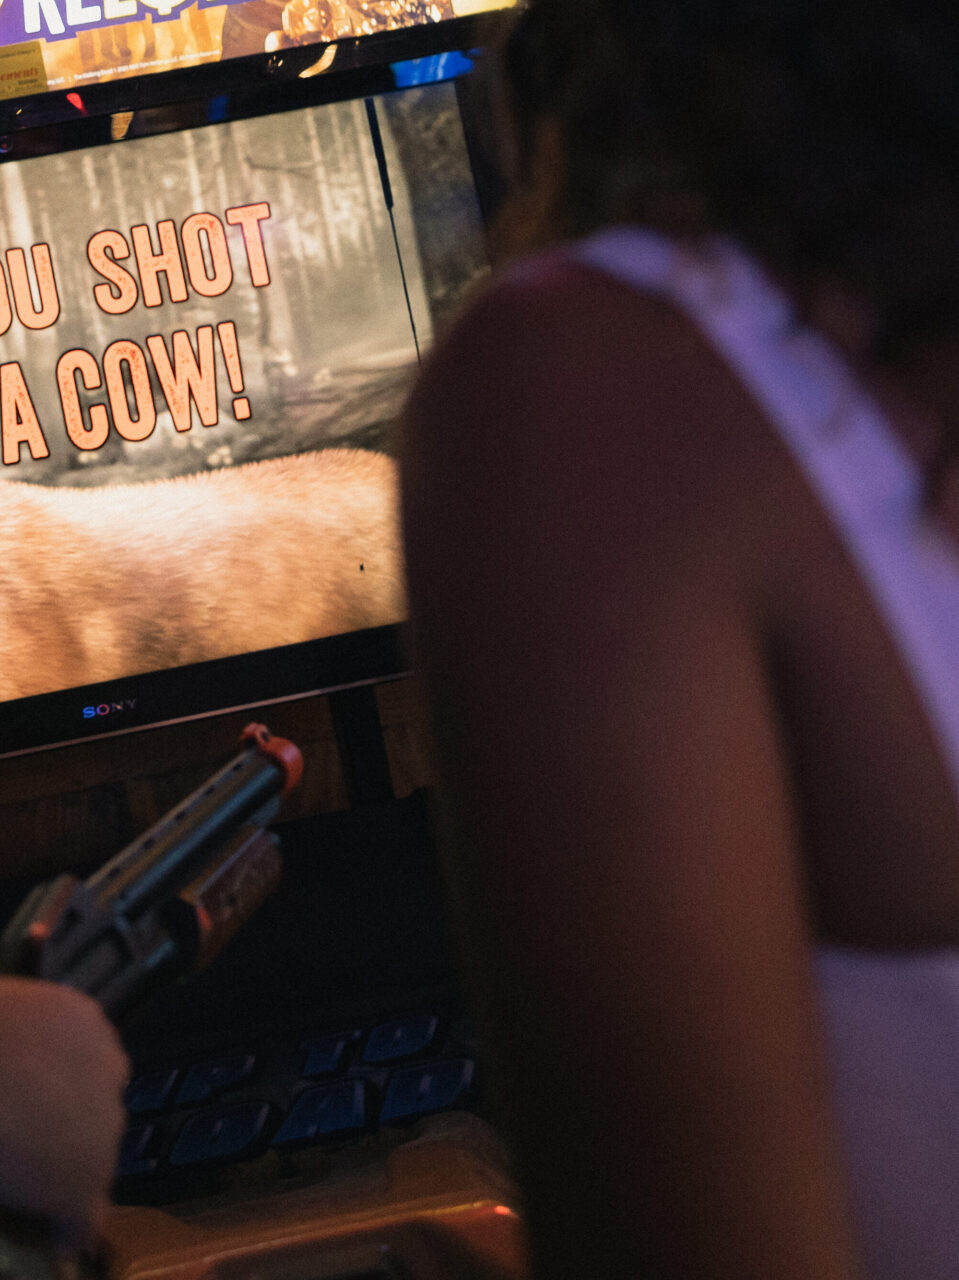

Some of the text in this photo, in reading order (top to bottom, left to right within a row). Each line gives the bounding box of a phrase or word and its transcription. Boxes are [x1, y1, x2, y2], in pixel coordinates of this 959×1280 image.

[85, 200, 273, 317] SHOT
[55, 320, 253, 454] COW!
[81, 699, 137, 719] SONY
